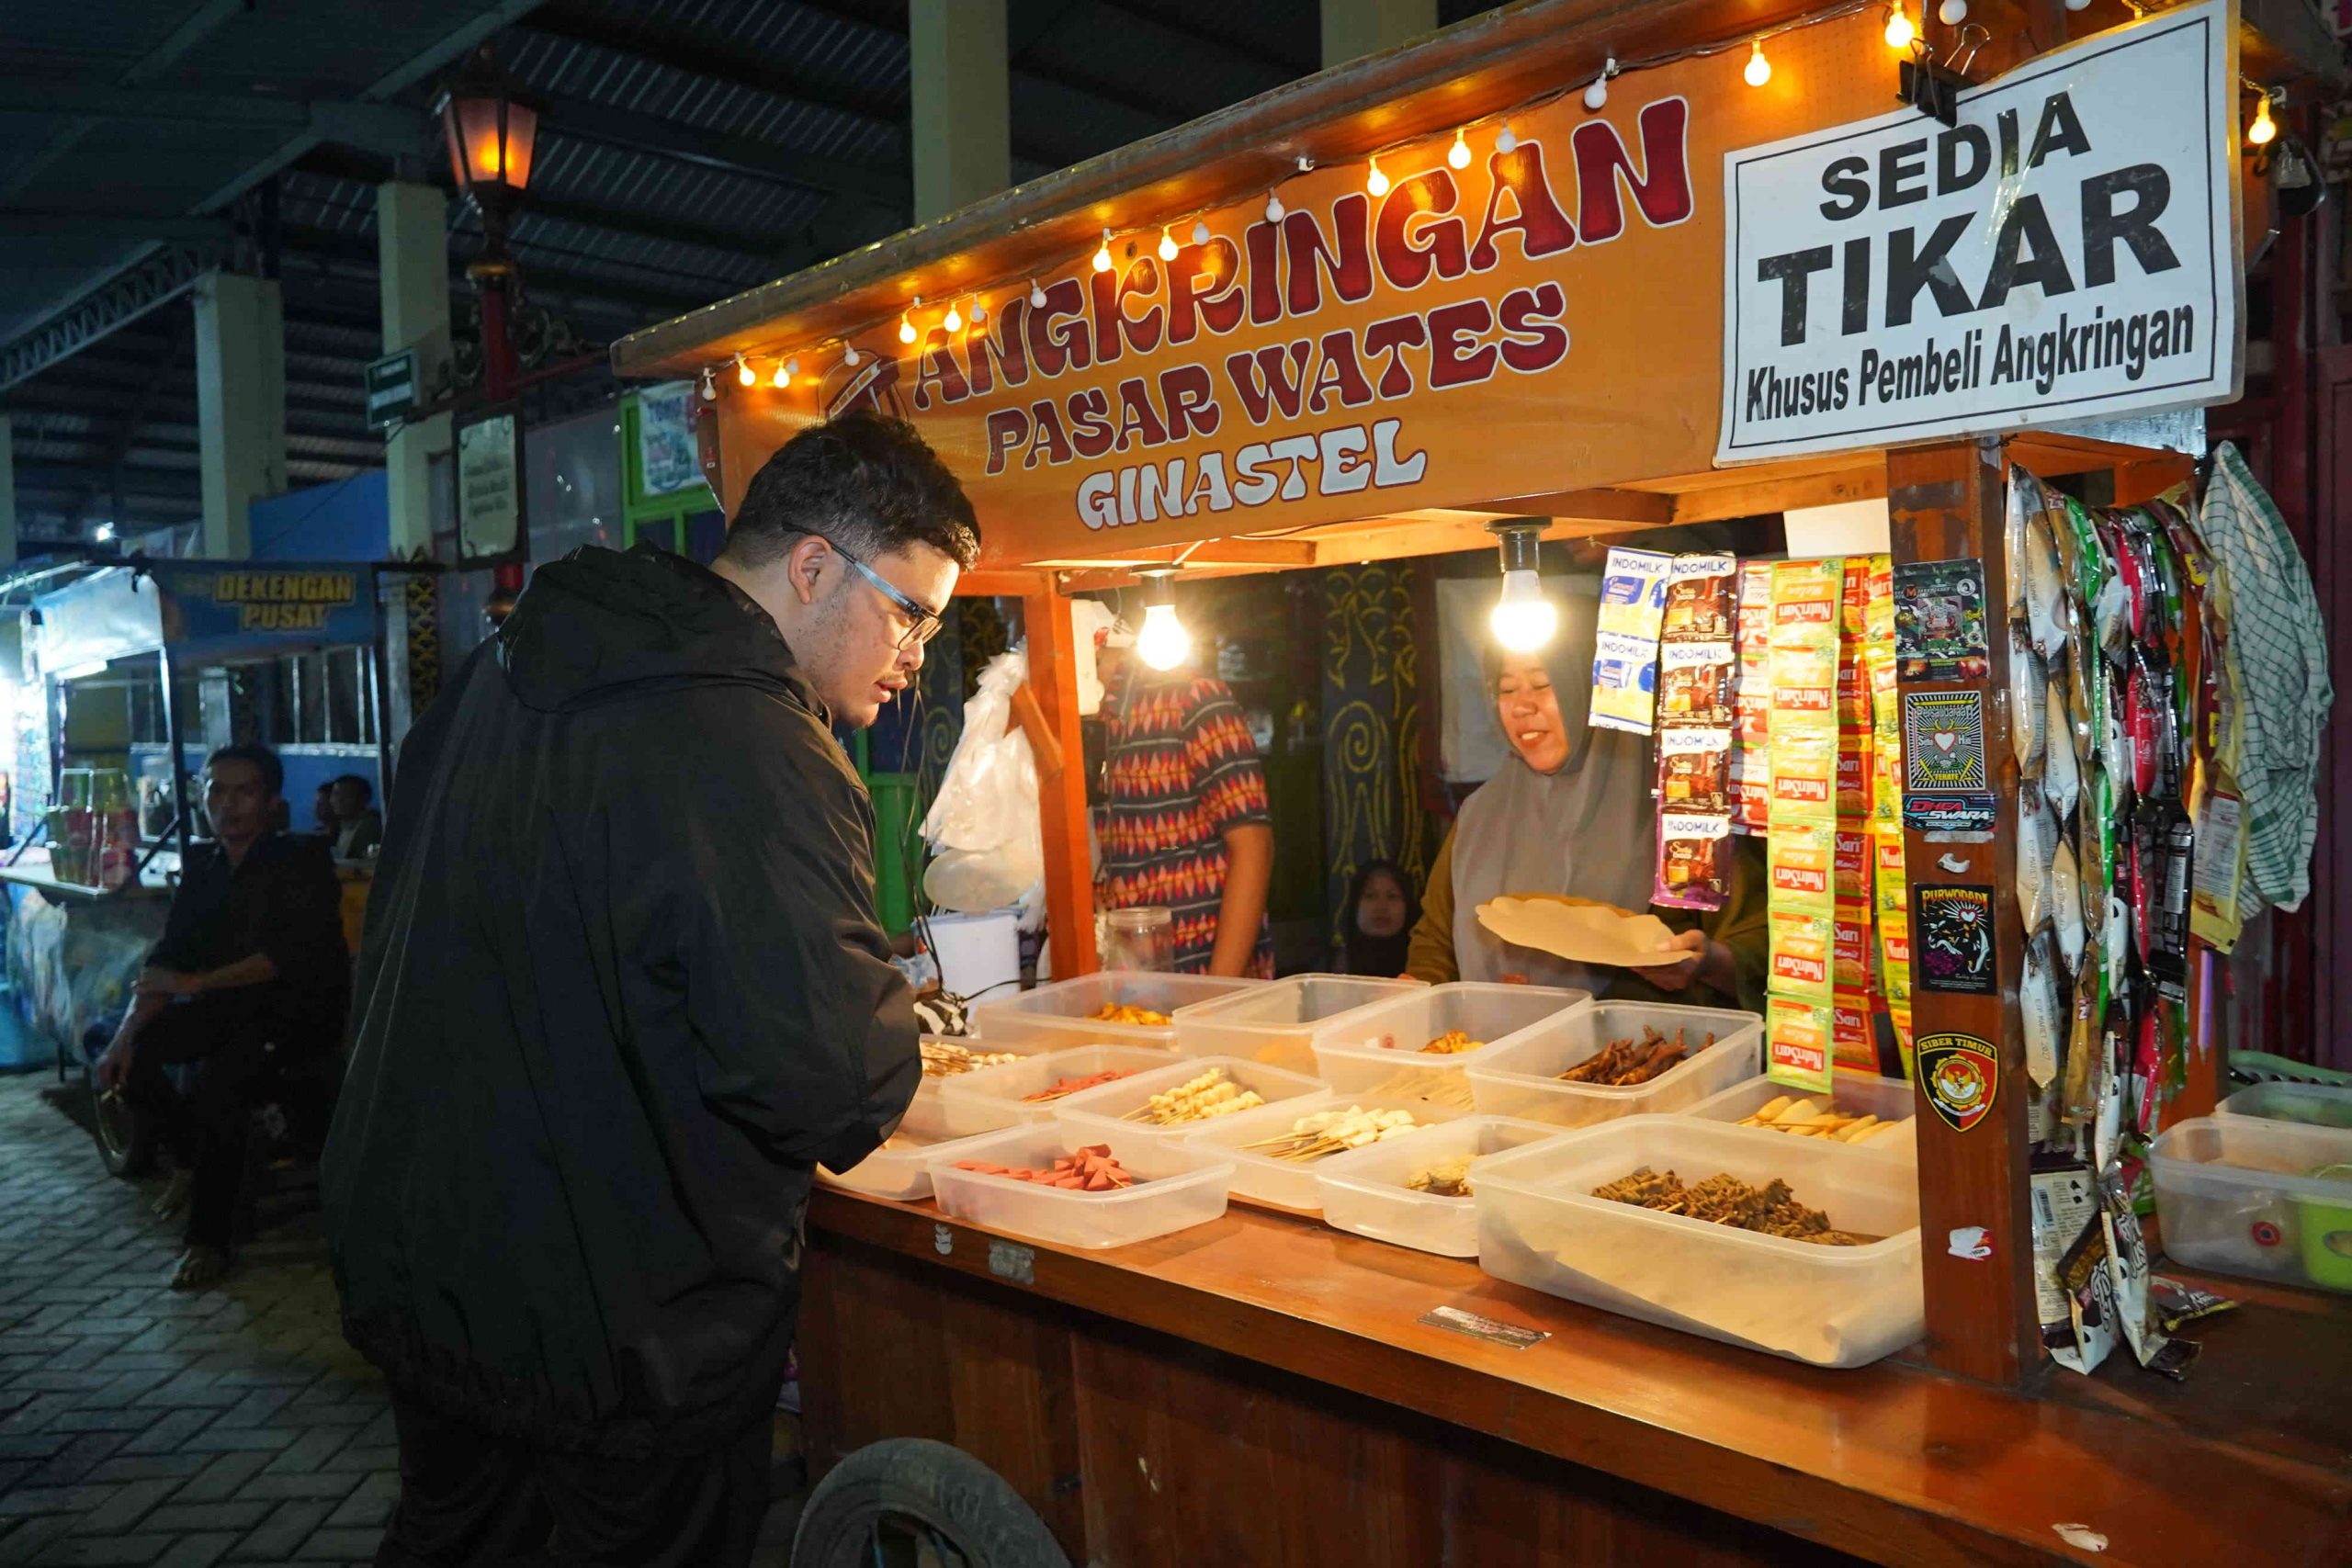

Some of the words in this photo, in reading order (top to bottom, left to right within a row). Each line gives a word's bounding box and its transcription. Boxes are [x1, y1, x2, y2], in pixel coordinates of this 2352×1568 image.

[1819, 90, 2092, 221] SEDIA
[913, 95, 1693, 411] ANGKRINGAN
[1758, 163, 2182, 346] TIKAR
[1747, 366, 1849, 423] Khusus
[1859, 330, 1983, 407] Pembeli
[1991, 303, 2194, 395] Angkringan
[986, 362, 1222, 476] PASAR
[1227, 281, 1571, 426] WATES
[1076, 418, 1427, 532] GINASTEL
[1612, 557, 1664, 574] INDOMILK
[1672, 560, 1727, 574] INDOMILK
[243, 604, 327, 628] PUSAT
[1668, 820, 1720, 833] INDOMILK
[1918, 810, 1991, 820] SWARA
[1921, 888, 1989, 911] PURWODADI
[1920, 1037, 1953, 1050] SIBER
[1954, 1038, 1993, 1056] TIMUR
